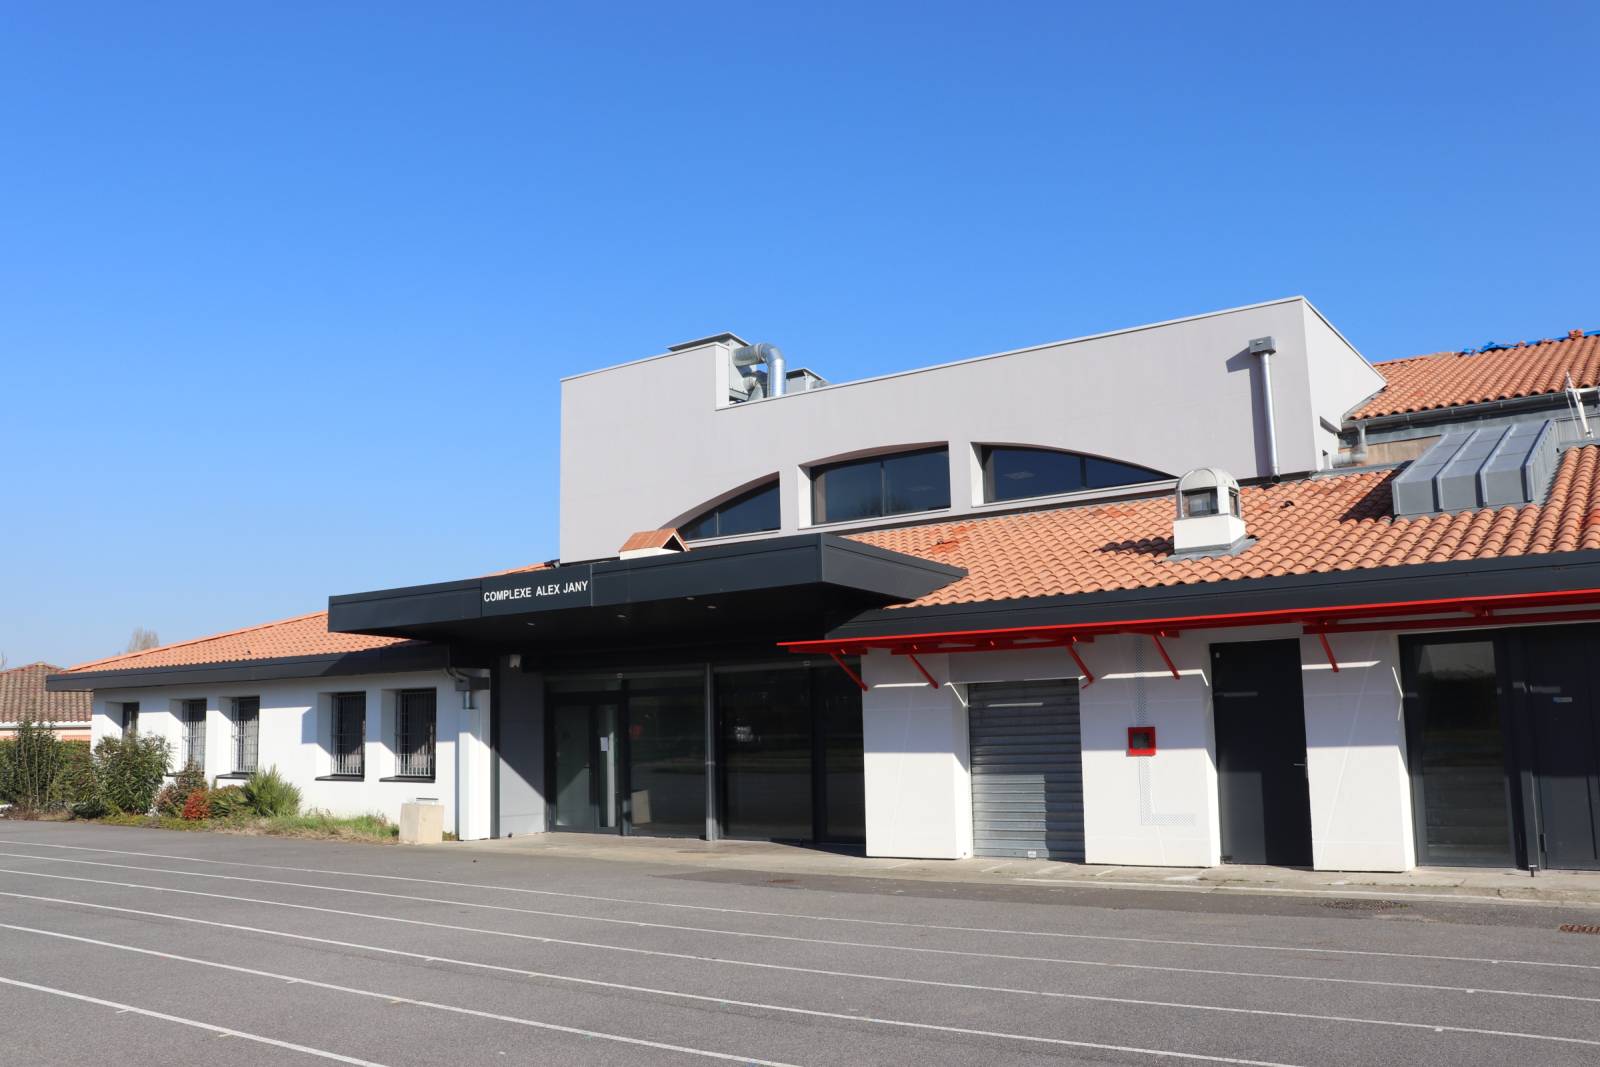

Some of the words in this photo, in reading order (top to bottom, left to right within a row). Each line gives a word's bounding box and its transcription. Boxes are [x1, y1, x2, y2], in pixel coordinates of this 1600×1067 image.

[484, 587, 532, 602] COMPLEXE
[536, 584, 560, 597] ALEX
[563, 580, 588, 594] JANY
